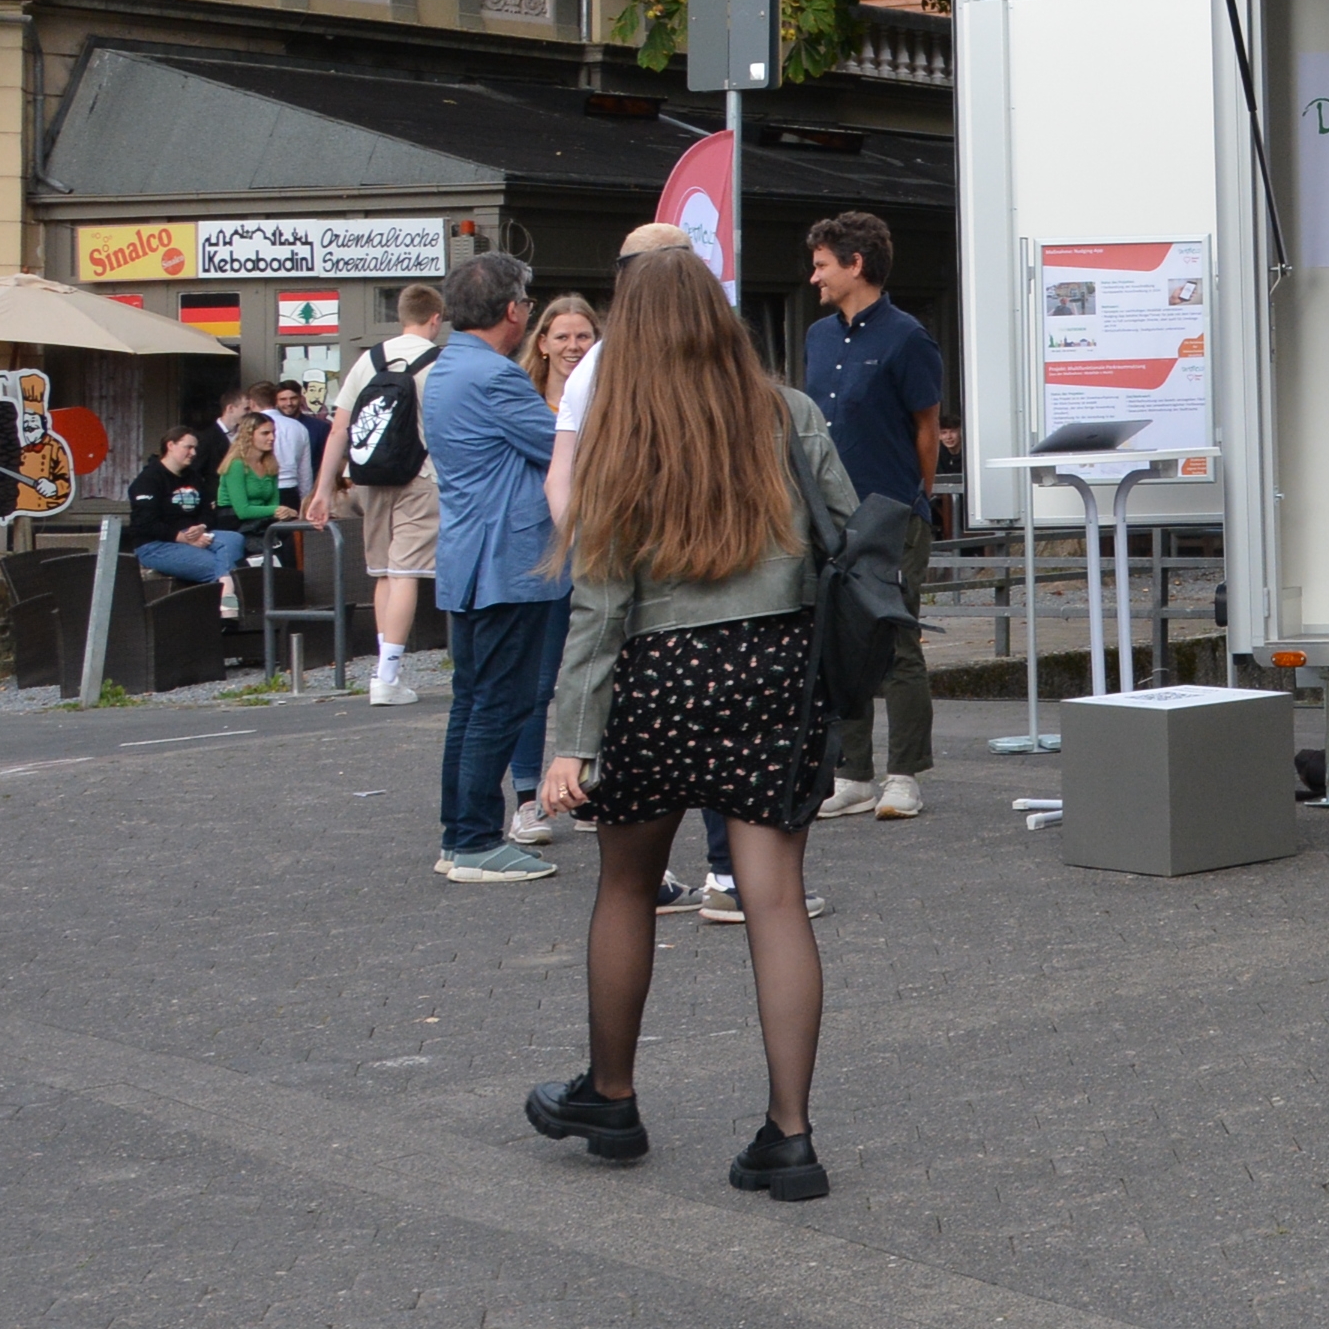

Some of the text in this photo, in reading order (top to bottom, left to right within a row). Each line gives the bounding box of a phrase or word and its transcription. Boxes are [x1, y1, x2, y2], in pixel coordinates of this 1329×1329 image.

[320, 228, 439, 249] Orientalische
[89, 228, 172, 276] Sinalco
[208, 250, 309, 272] Kebabadin
[322, 251, 441, 275] Spezialitäten
